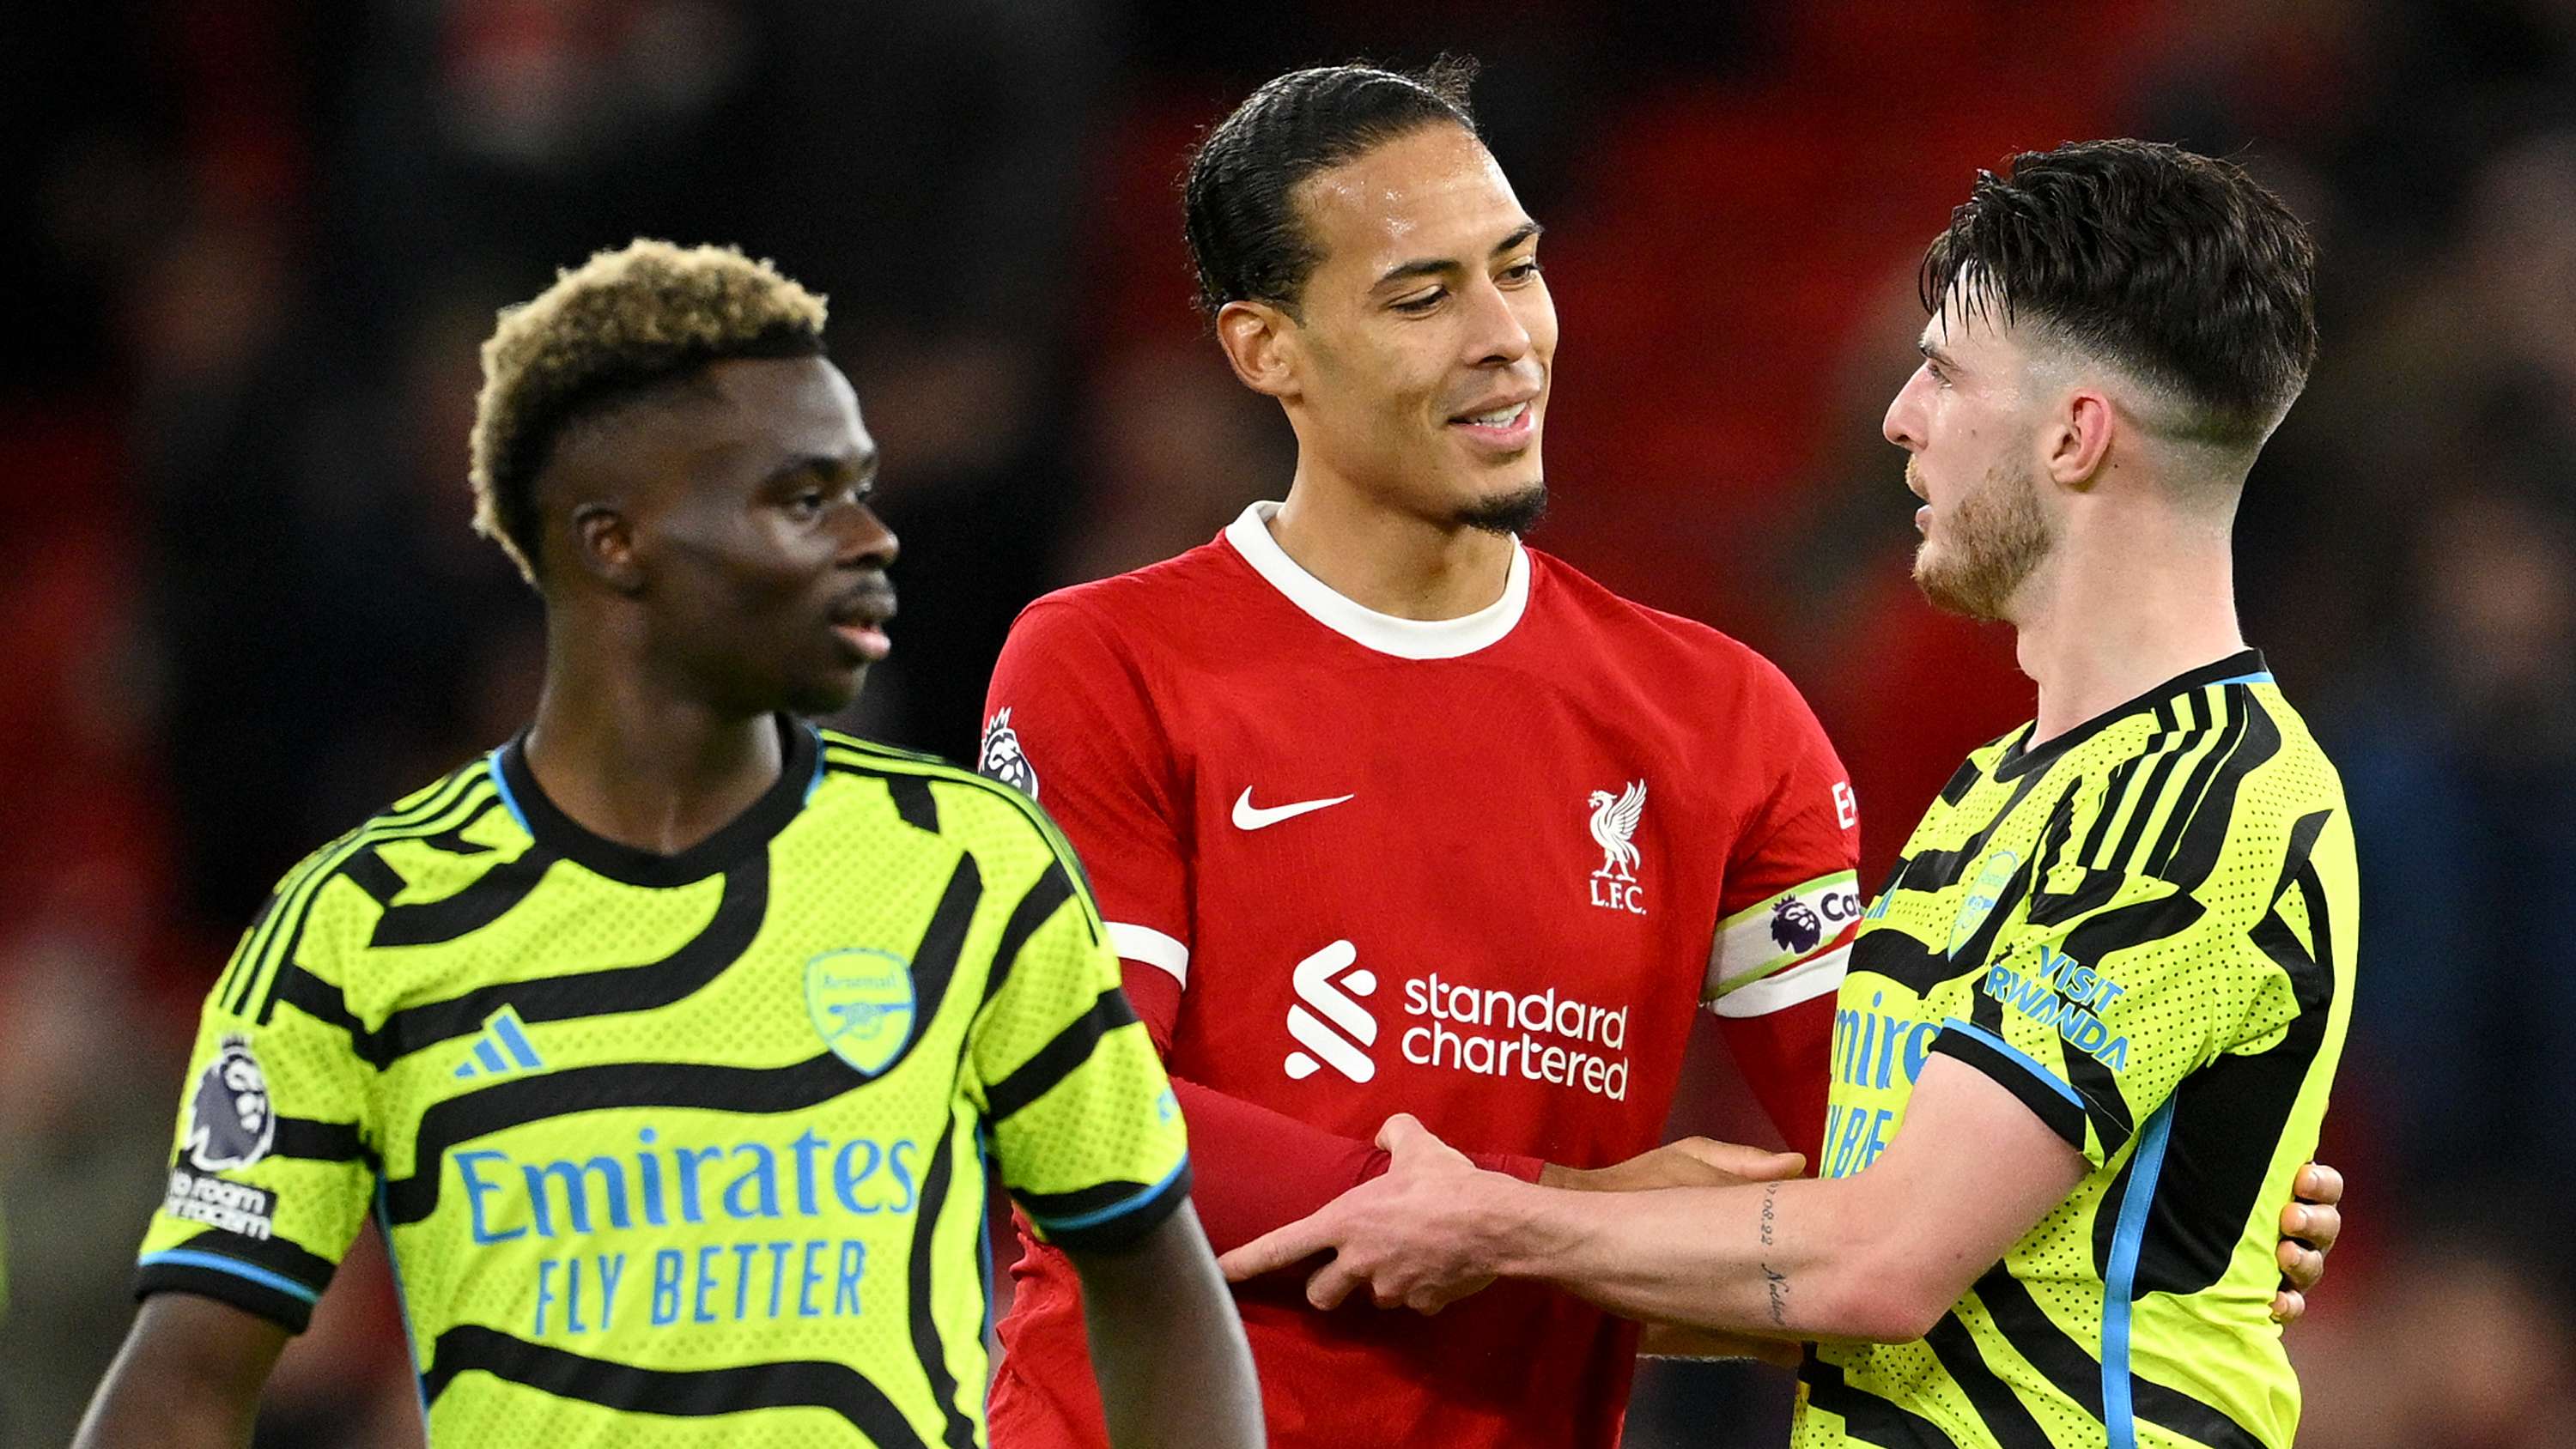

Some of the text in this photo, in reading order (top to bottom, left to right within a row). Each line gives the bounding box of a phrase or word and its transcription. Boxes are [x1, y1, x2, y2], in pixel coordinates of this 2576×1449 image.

[1832, 781, 1857, 830] E
[1589, 879, 1647, 915] L.F.C.
[1820, 892, 1859, 922] Ca
[1404, 973, 1628, 1051] standard
[2038, 944, 2124, 1013] VISIT
[1983, 963, 2130, 1073] RWANDA
[1401, 1020, 1629, 1101] chartered
[453, 1126, 918, 1245] Emirates
[533, 1240, 866, 1337] FLY BETTER
